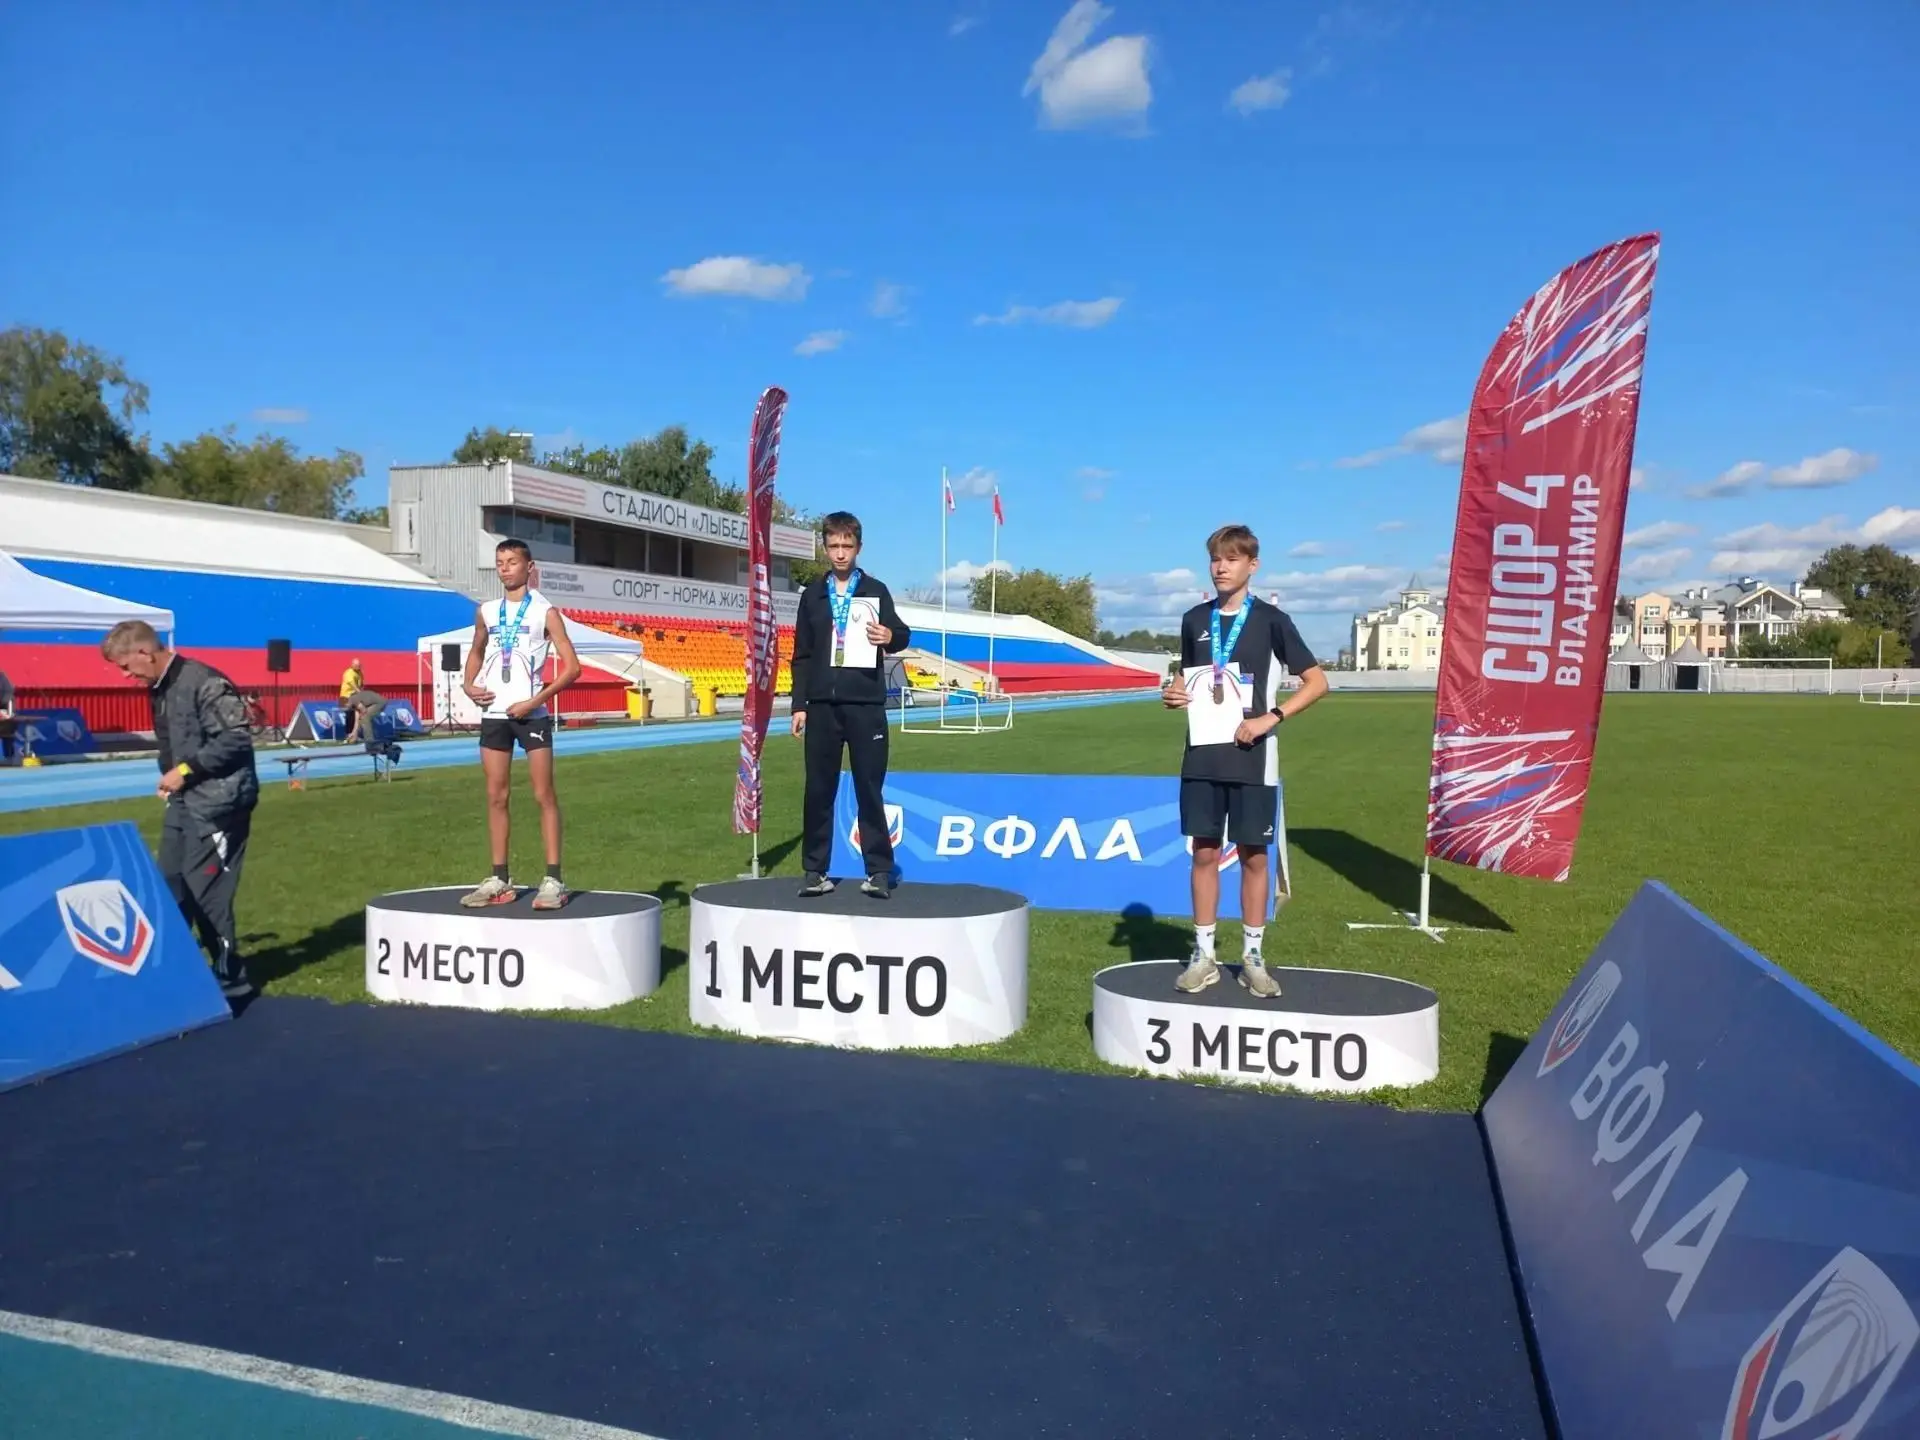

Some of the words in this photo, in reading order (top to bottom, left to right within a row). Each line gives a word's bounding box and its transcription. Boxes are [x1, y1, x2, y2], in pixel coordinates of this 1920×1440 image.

[602, 491, 687, 528] СТАДИОН
[1497, 474, 1565, 510] 4
[613, 578, 660, 600] СПОРТ
[673, 585, 717, 606] НОРМА
[1481, 523, 1560, 684] СШОР
[1555, 473, 1601, 687] ВЛАДИМИР
[935, 814, 1144, 862] ВФЛА
[377, 937, 391, 976] 2
[403, 940, 525, 988] МЕСТО
[704, 940, 723, 999] 1
[742, 945, 948, 1018] МЕСТО
[1145, 1018, 1171, 1065] 3
[1192, 1022, 1368, 1082] МЕСТО
[1569, 1021, 1750, 1323] ВФЛА
